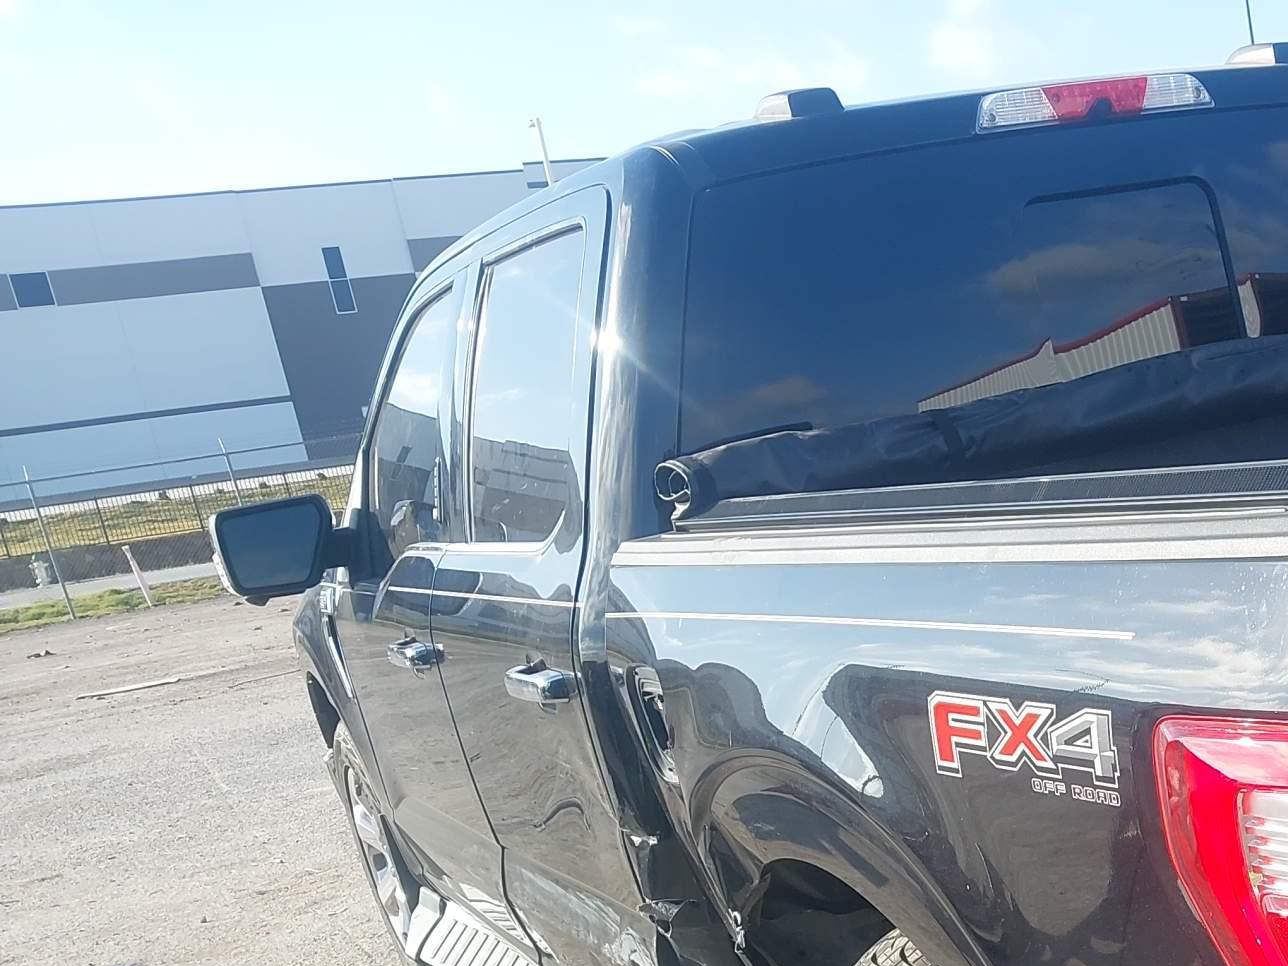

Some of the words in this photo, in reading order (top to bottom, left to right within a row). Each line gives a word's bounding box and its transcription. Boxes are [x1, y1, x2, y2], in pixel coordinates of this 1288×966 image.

[927, 690, 1120, 789] FX4
[1031, 777, 1067, 795] OFF
[1071, 784, 1121, 807] ROAD
